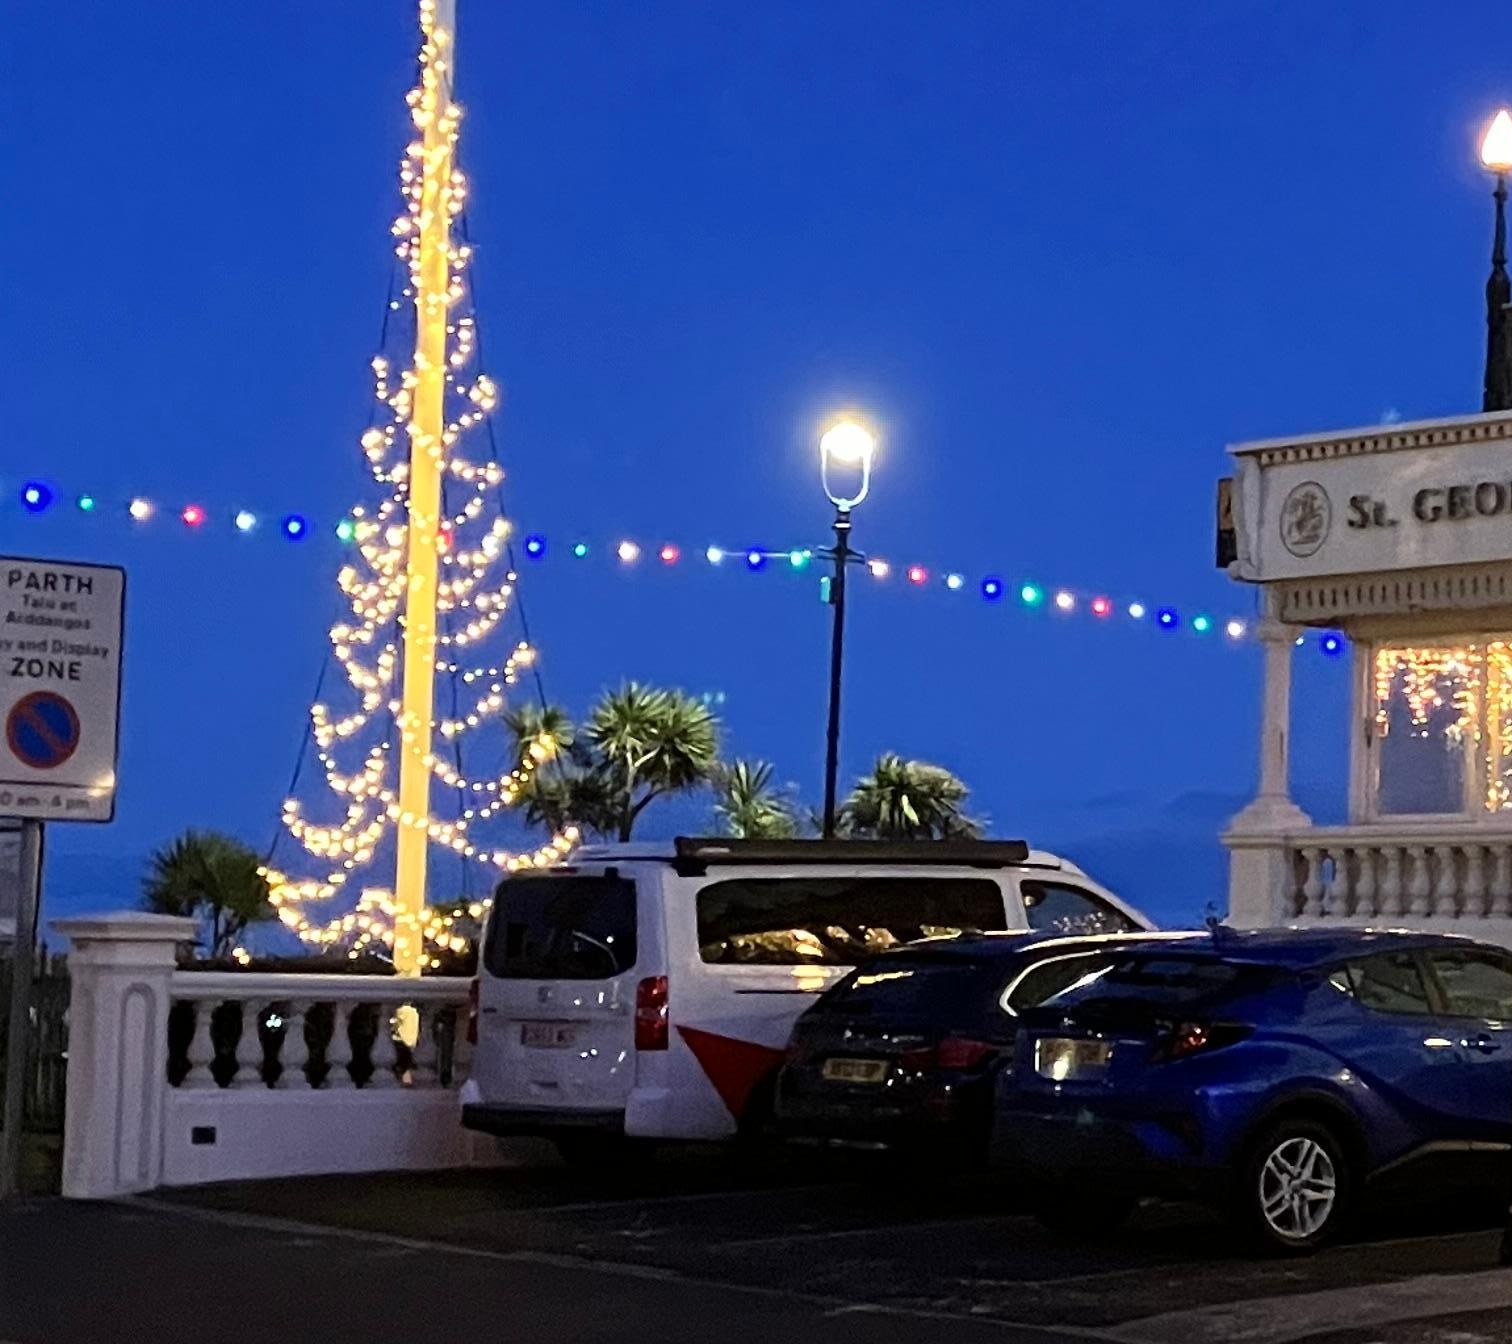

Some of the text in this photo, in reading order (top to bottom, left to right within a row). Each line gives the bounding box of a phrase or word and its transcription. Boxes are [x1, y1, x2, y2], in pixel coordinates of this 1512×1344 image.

[8, 569, 93, 595] PARTH
[18, 639, 47, 652] and
[51, 639, 109, 660] Display
[11, 657, 82, 681] ZONE
